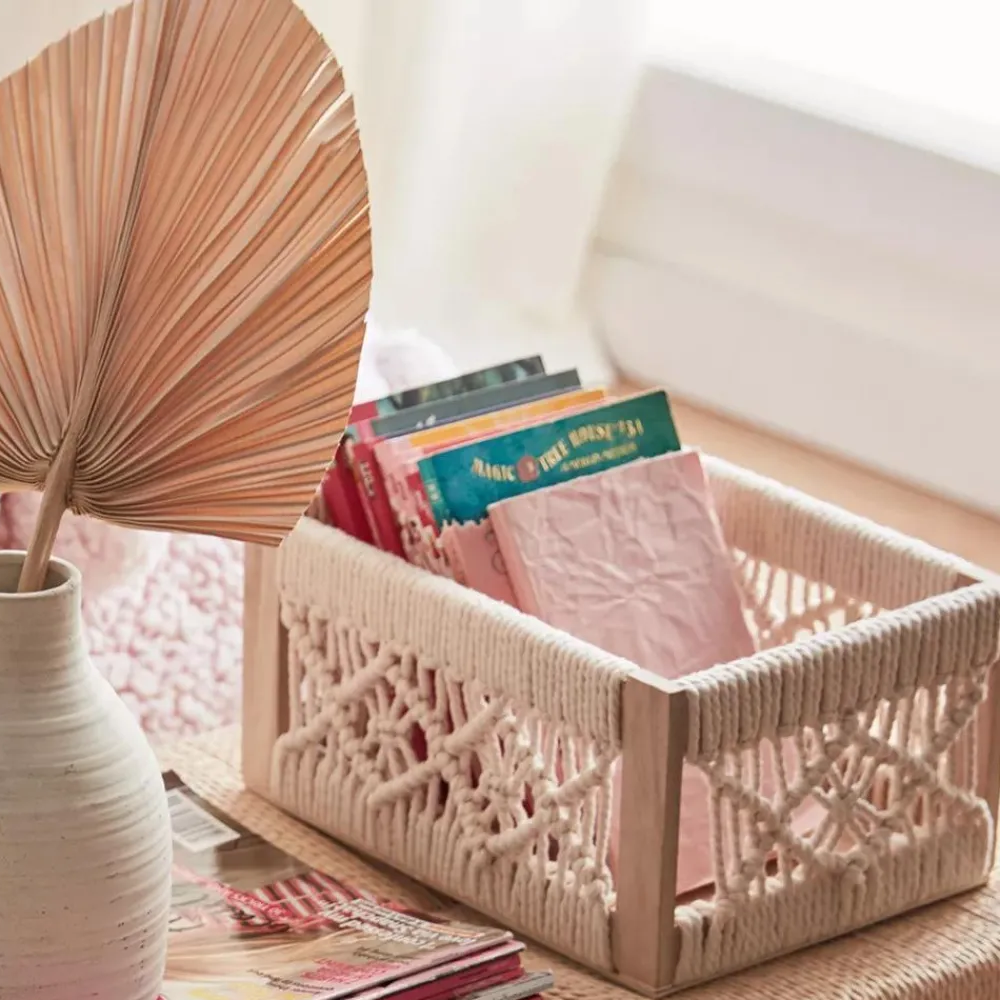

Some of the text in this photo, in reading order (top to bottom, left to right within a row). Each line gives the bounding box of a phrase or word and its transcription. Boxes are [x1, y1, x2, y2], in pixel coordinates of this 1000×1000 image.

[472, 457, 515, 482] MAGIC
[539, 438, 569, 472] TREE
[568, 423, 613, 449] HOUSE
